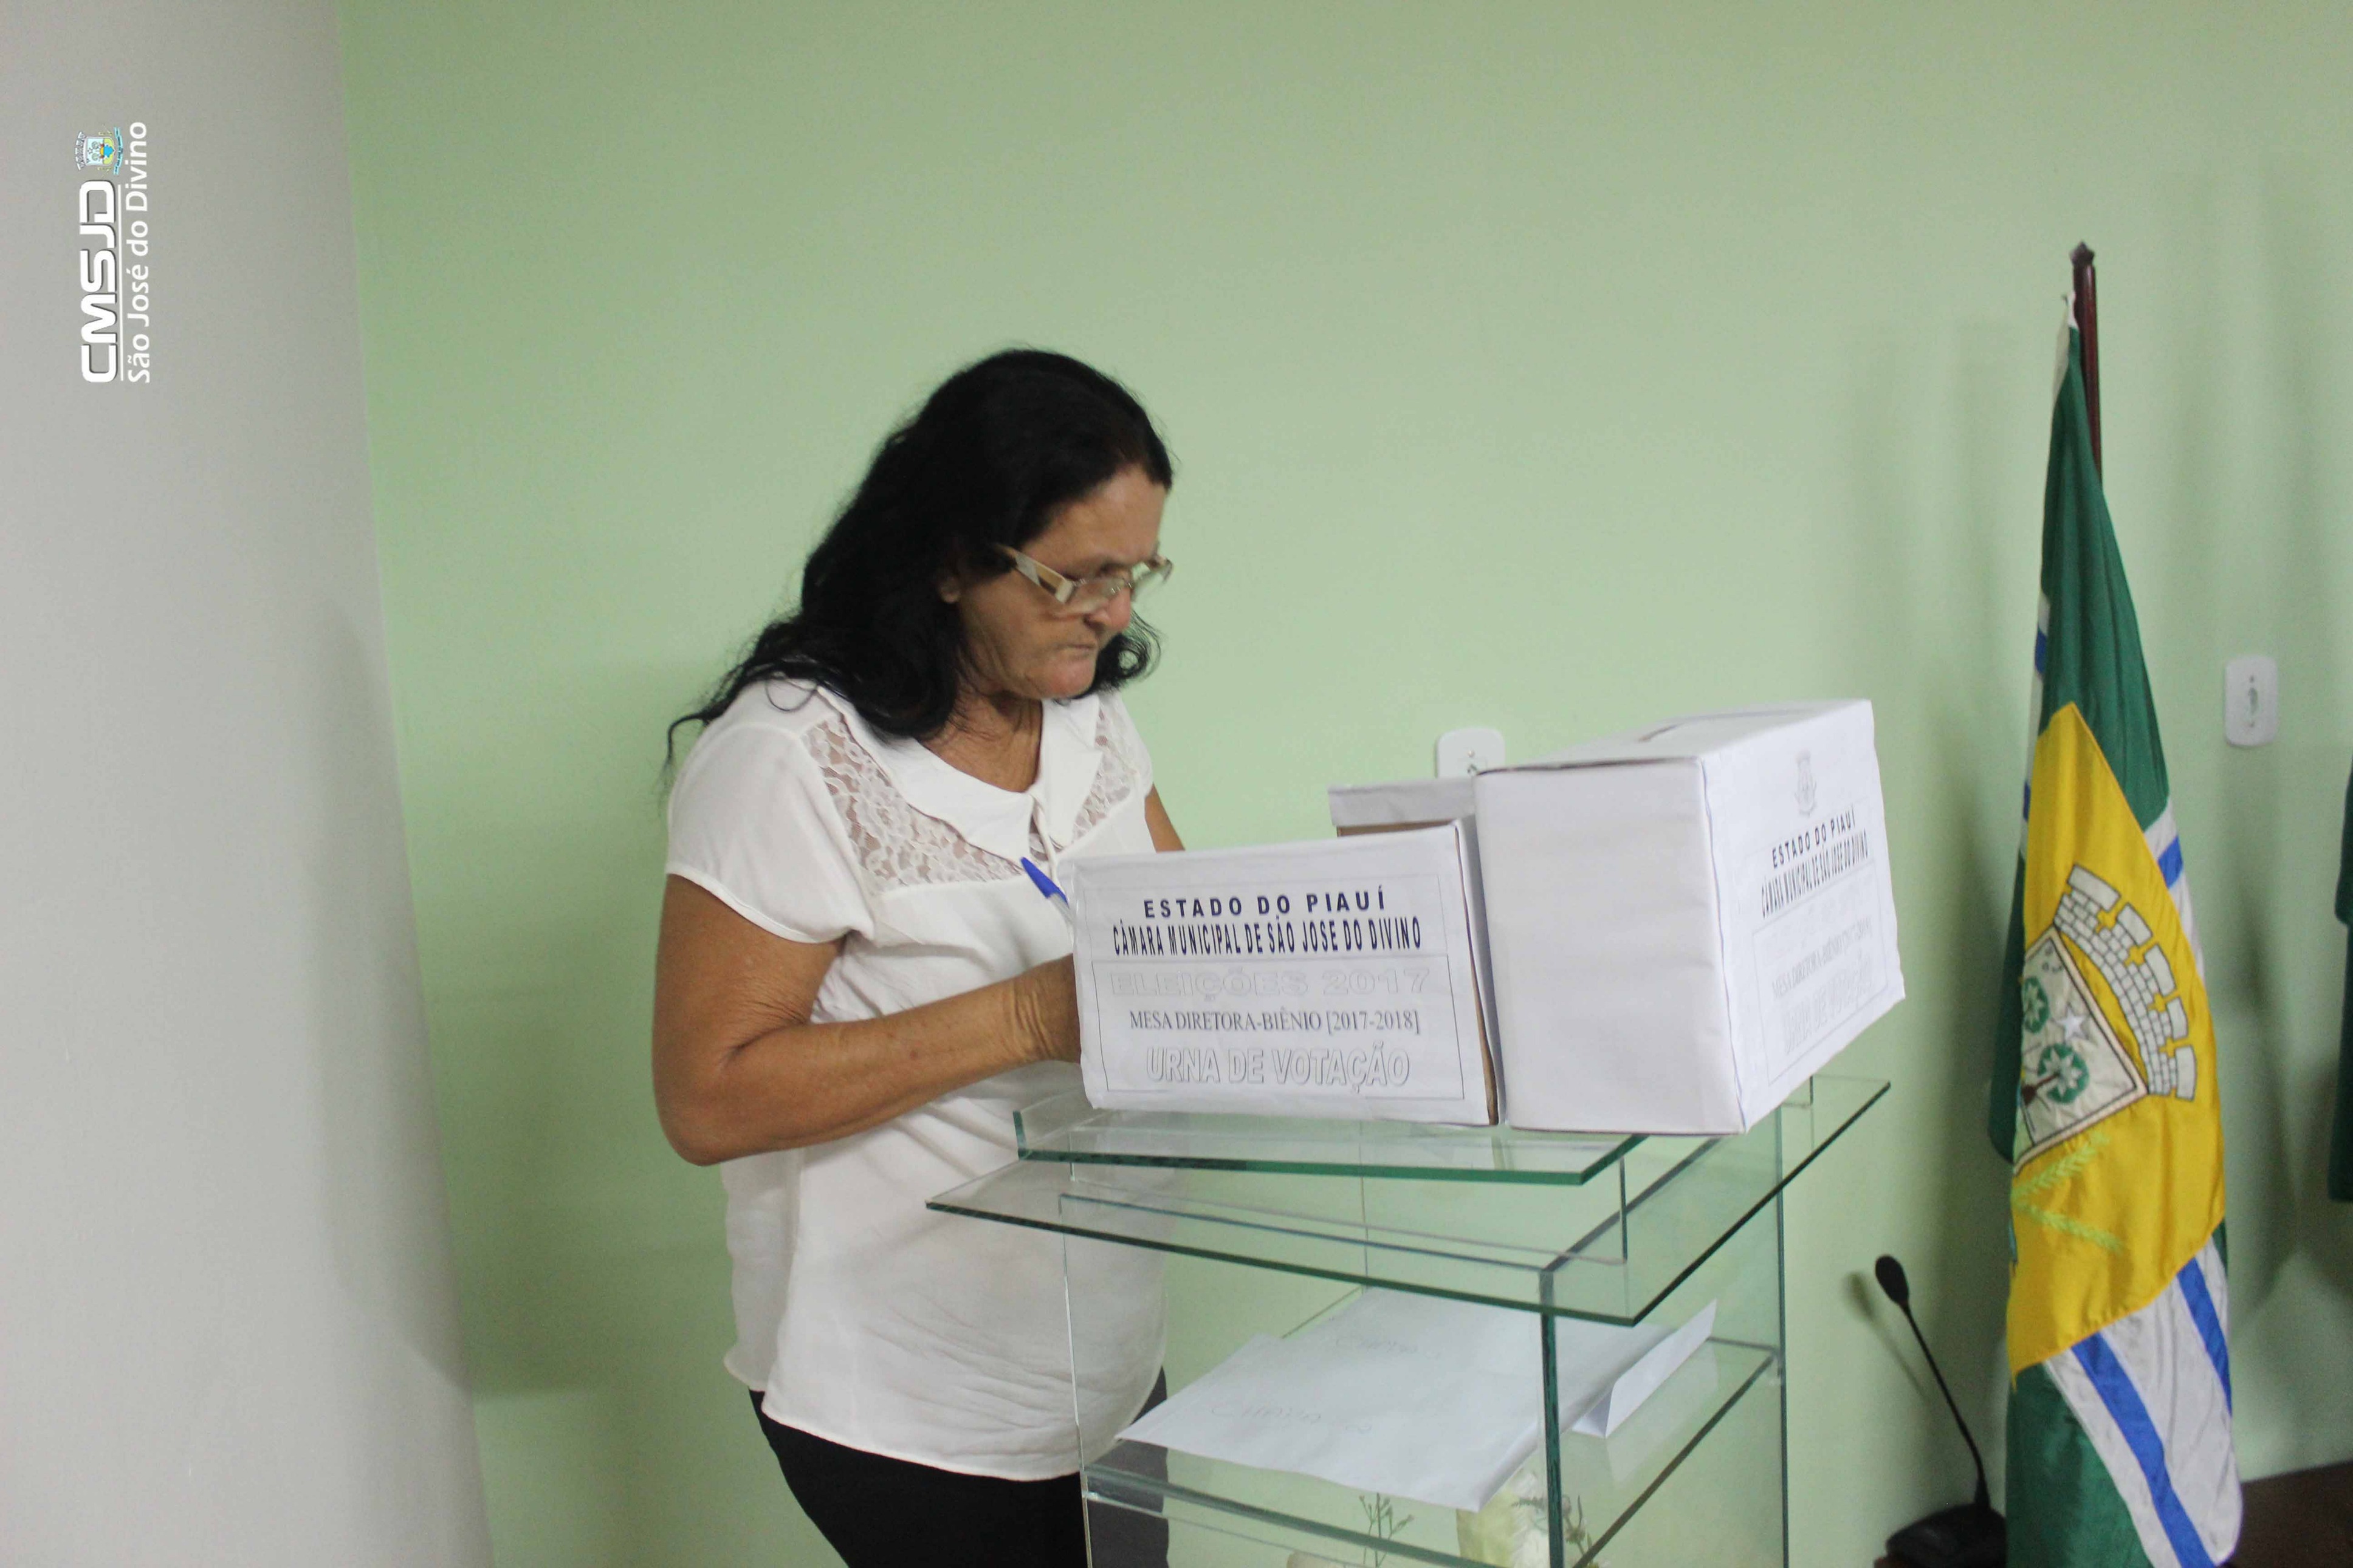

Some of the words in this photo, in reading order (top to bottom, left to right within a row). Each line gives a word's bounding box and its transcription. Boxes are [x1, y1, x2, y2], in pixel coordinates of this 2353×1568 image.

[1772, 831, 1811, 869] ESTADO
[1815, 822, 1827, 846] DO
[1144, 897, 1242, 919] ESTADO
[1257, 895, 1290, 915] DO
[1307, 885, 1384, 913] PIAUÍ
[1167, 923, 1242, 956] MUNICIPAL
[1245, 922, 1263, 954] DE
[1267, 914, 1294, 954] SÃO
[1302, 919, 1338, 953] JOSE
[1342, 918, 1362, 951] DO
[1368, 915, 1421, 950] DIVINO
[1110, 967, 1308, 1002] ELEIÇÕES
[1322, 967, 1429, 995] 2017
[1326, 1009, 1421, 1035] [2017-2018]
[1146, 1046, 1221, 1083] URNA
[1228, 1047, 1265, 1084] DE
[1271, 1039, 1410, 1094] VOTAÇÃO
